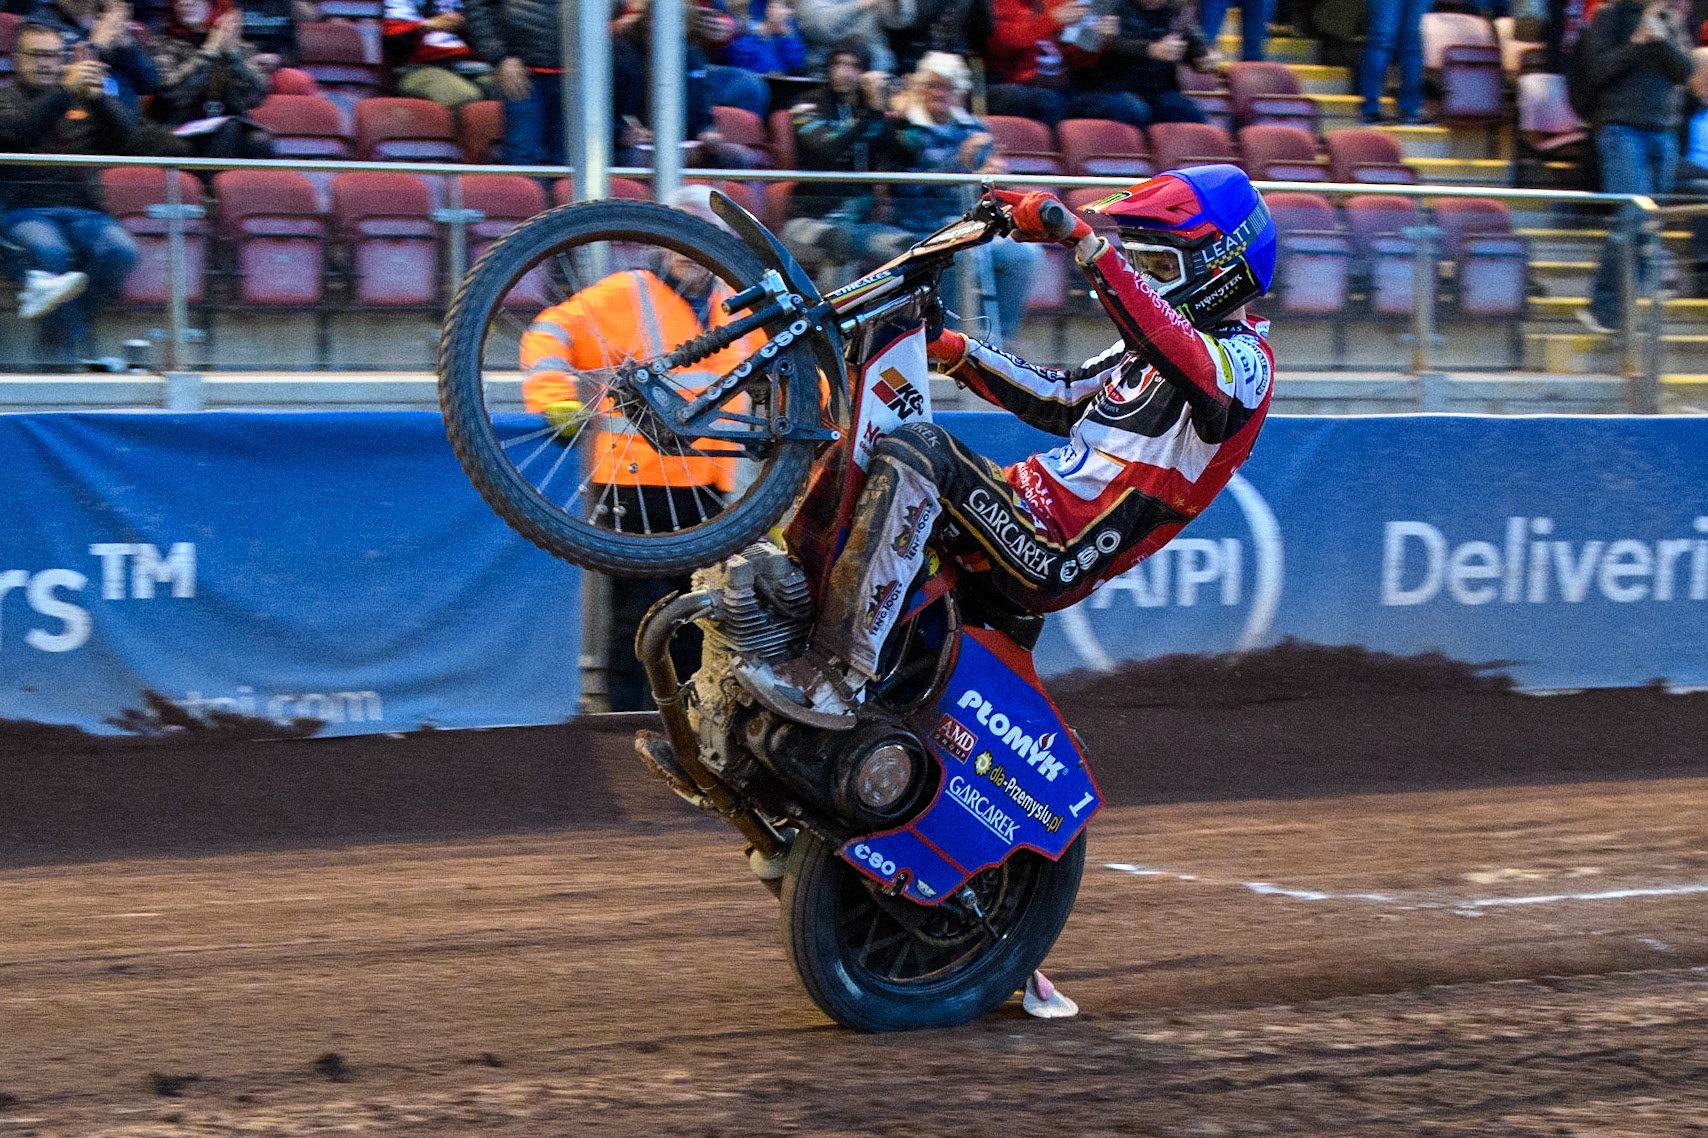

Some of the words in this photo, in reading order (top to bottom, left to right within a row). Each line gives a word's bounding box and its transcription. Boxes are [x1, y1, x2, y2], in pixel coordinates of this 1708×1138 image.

[1202, 220, 1251, 264] LEATT
[1194, 274, 1243, 310] MONSTER
[968, 488, 1057, 576] GARCAREK
[1382, 516, 1708, 605] Deliveri
[938, 719, 975, 749] AMD
[949, 775, 1021, 842] GARCAREK
[1069, 791, 1095, 818] 1
